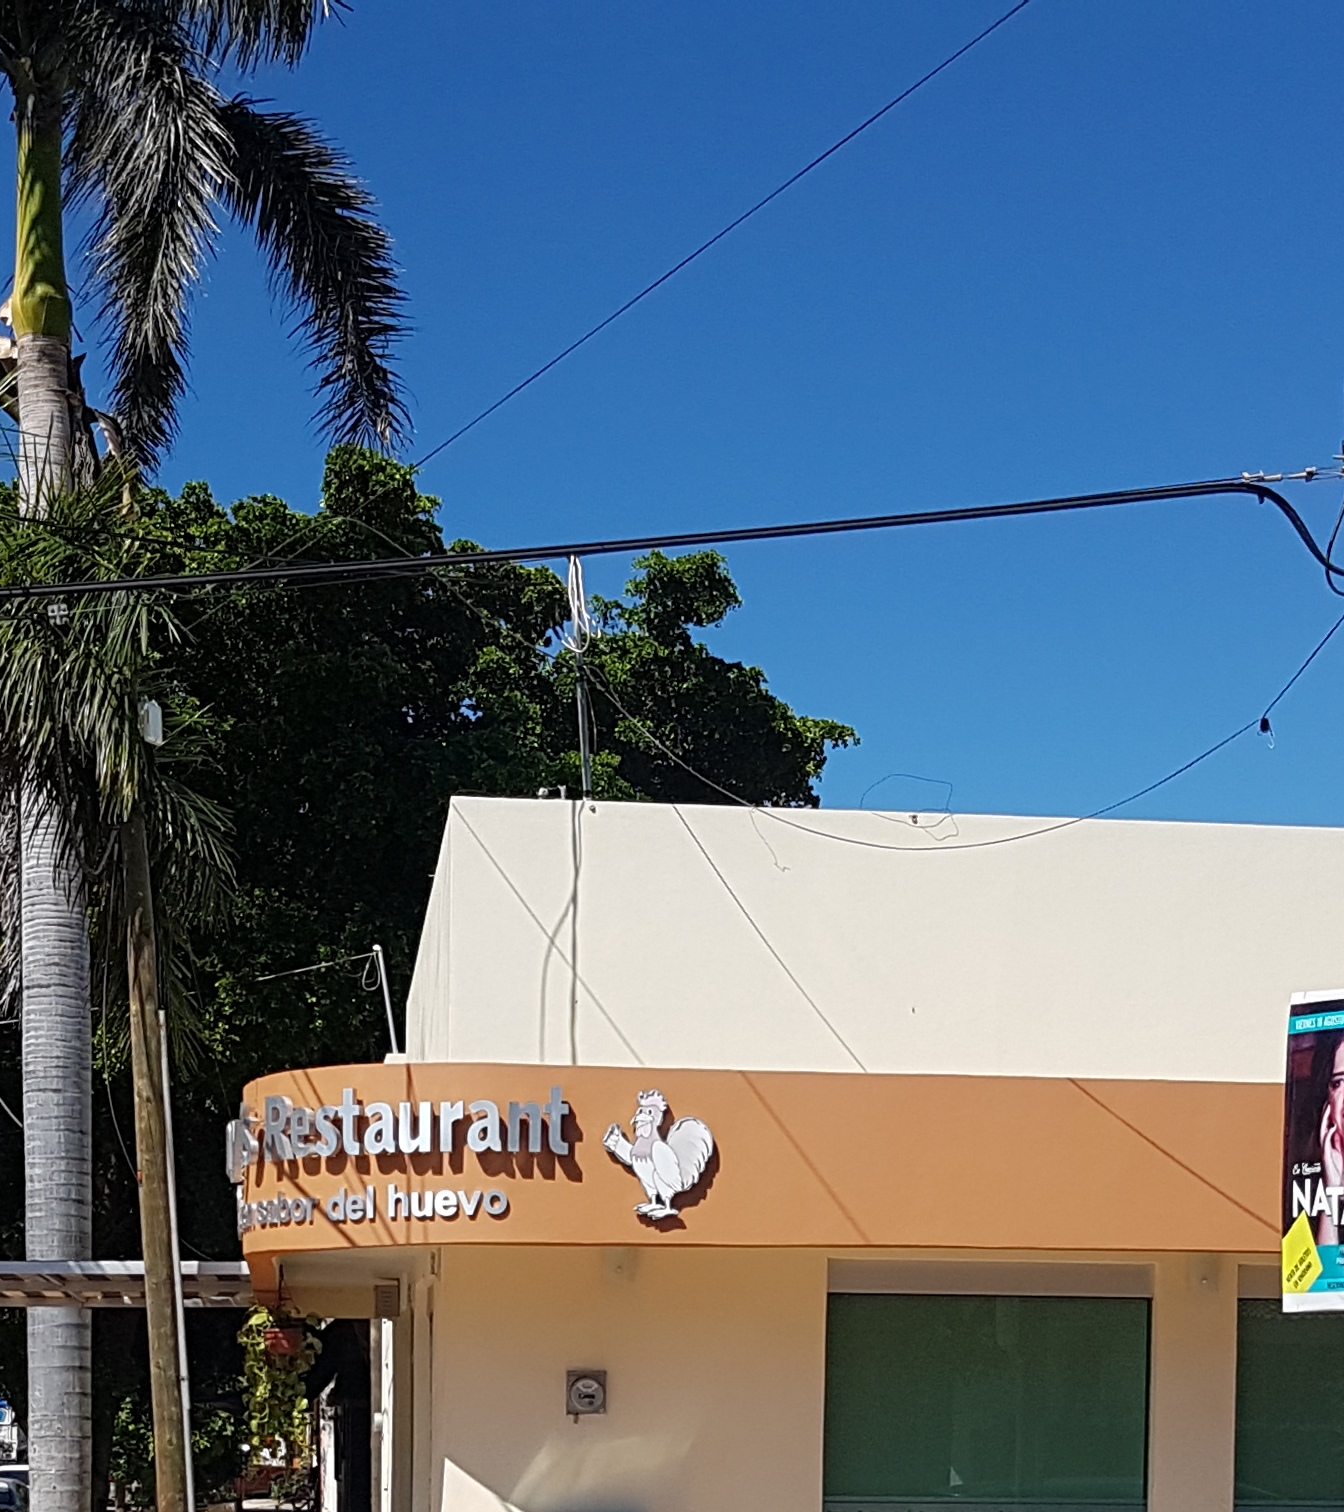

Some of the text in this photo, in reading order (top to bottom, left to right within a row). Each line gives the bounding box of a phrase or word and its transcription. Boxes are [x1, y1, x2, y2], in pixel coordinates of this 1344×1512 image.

[264, 1086, 571, 1161] Restaurant
[327, 1186, 375, 1221] del
[388, 1184, 508, 1219] huevo
